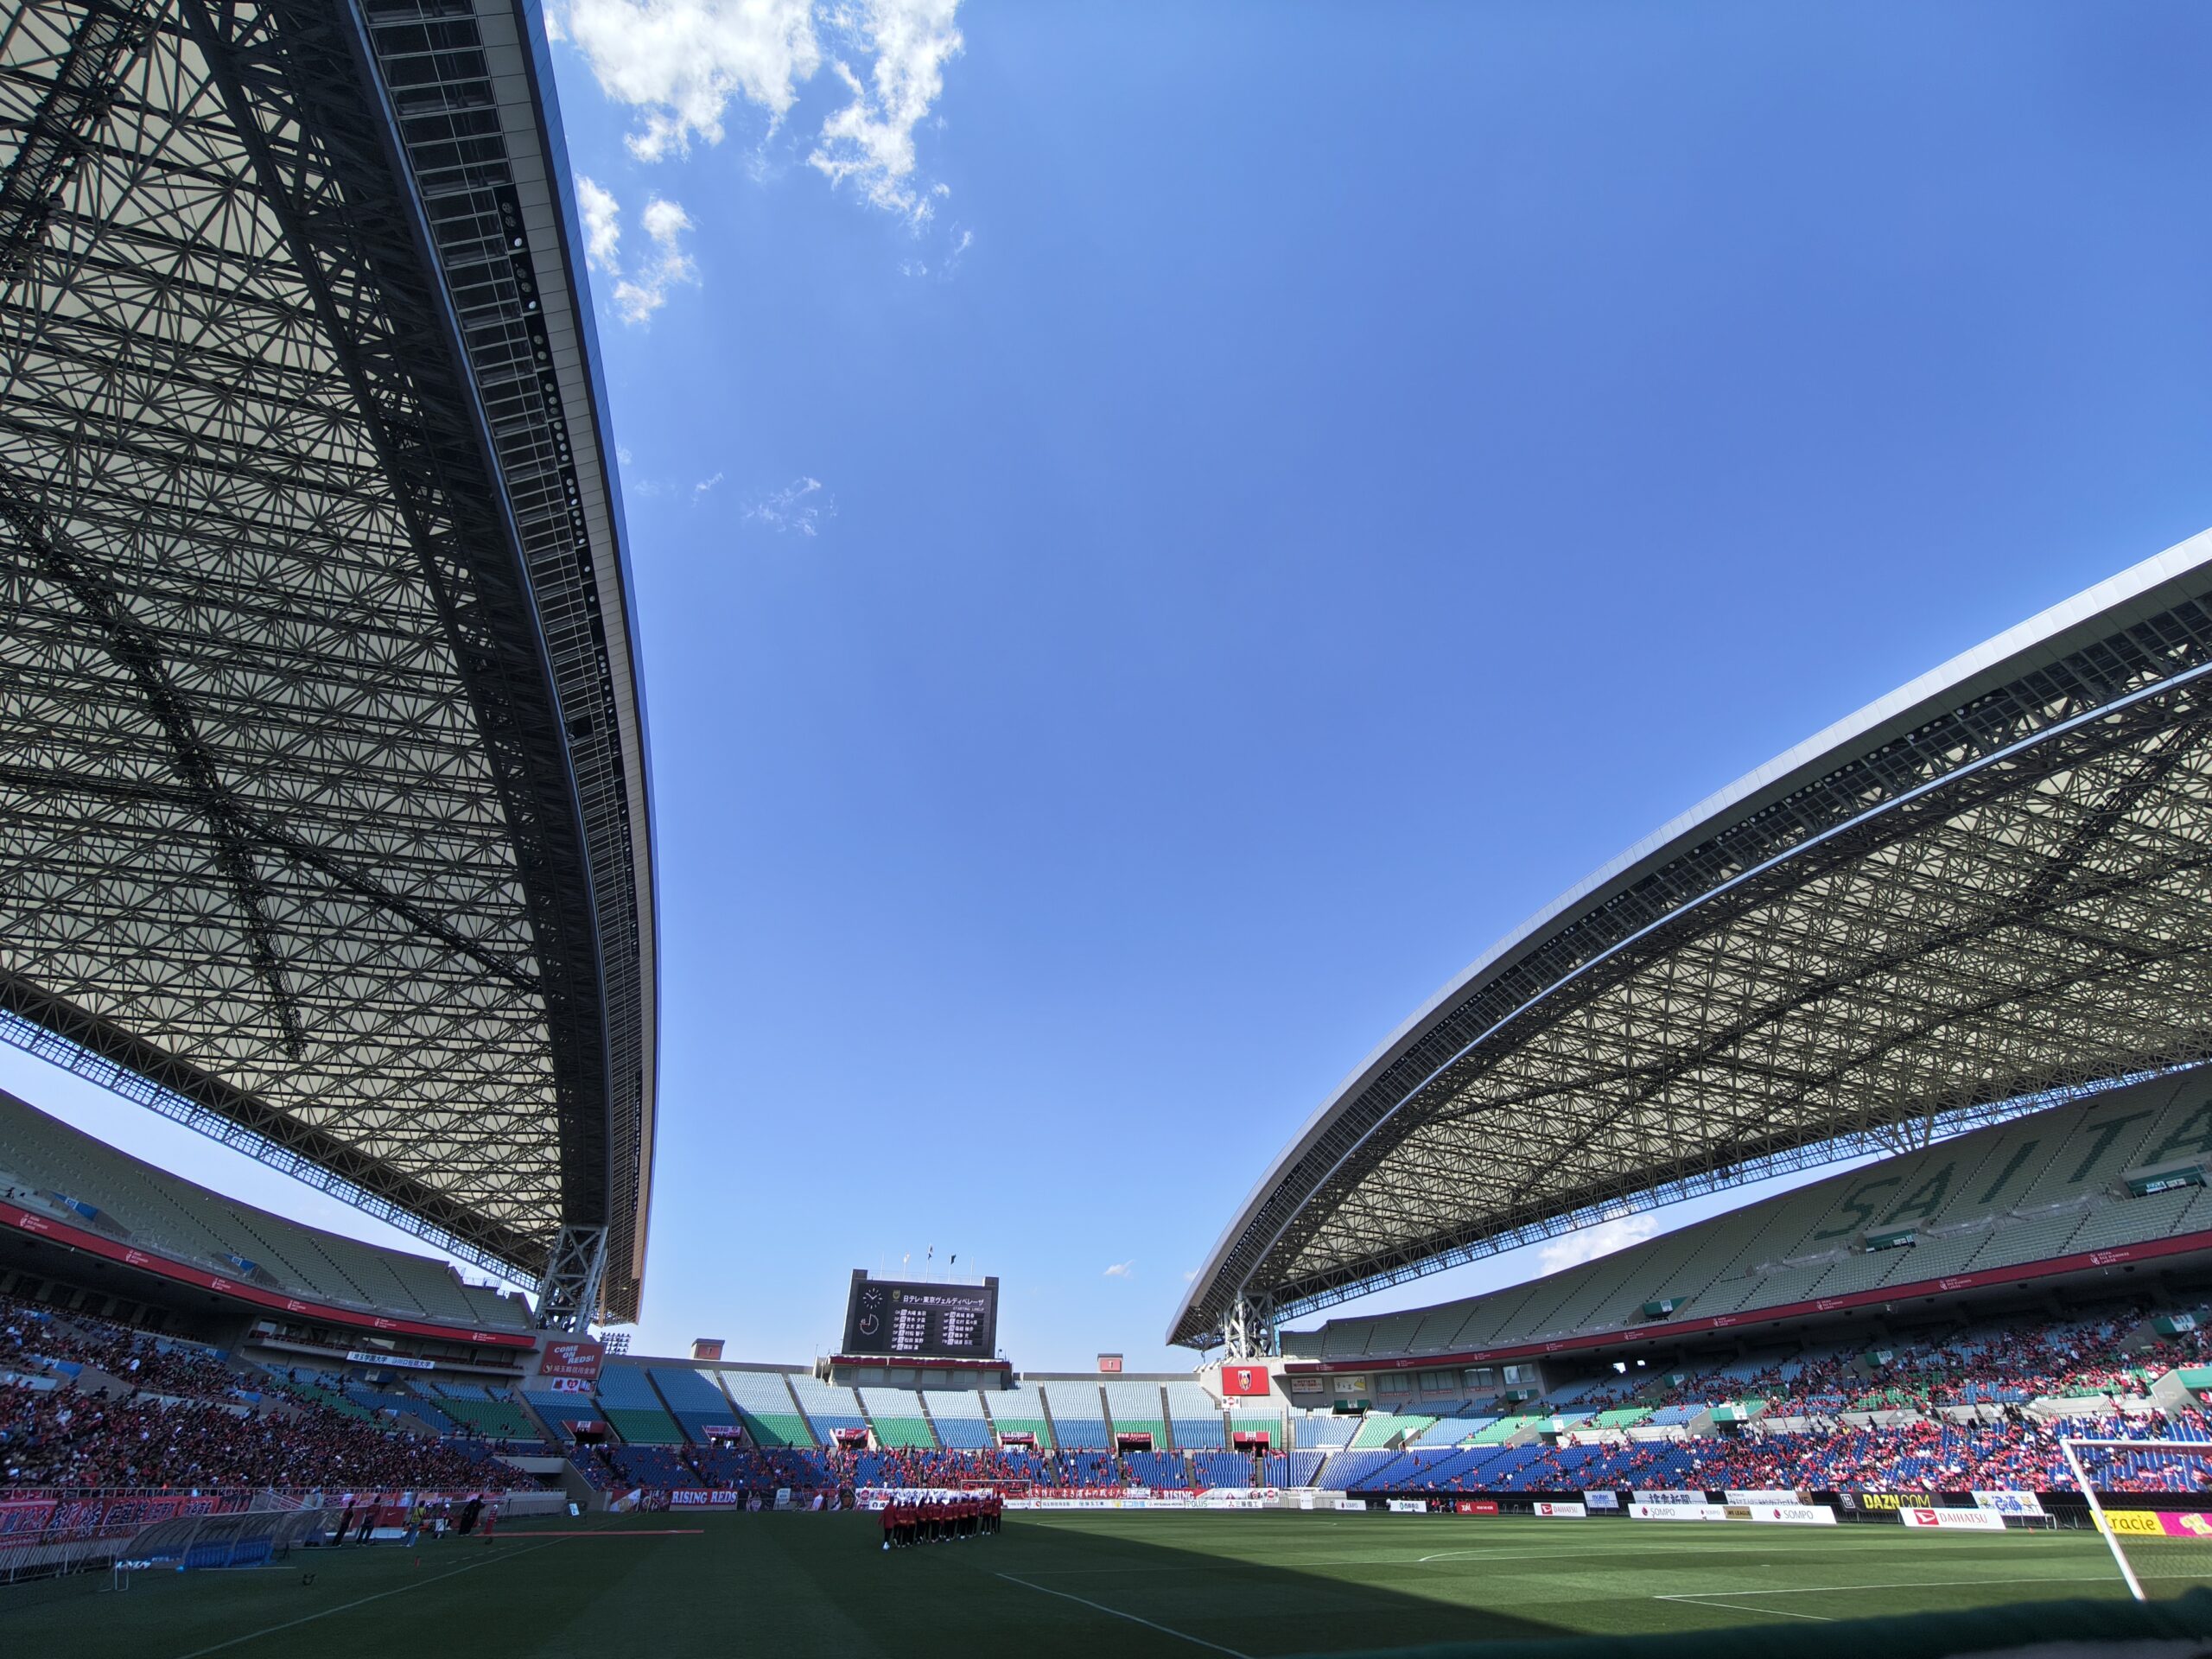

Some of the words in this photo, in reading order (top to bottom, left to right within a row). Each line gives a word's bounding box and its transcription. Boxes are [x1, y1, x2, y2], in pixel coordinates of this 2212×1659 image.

[554, 1345, 579, 1354] COME
[568, 1355, 594, 1364] REDS!
[671, 1491, 707, 1503] RISING
[710, 1491, 737, 1503] REDS
[1164, 1491, 1195, 1500] RISING
[1862, 1494, 1931, 1510] DAZNCOM
[1553, 1505, 1579, 1514] DAIHATSU
[1650, 1508, 1675, 1516] SOMPO
[1783, 1510, 1814, 1520] SOMPO
[1939, 1513, 1988, 1524] DAIHATSU
[2105, 1515, 2157, 1531] racie
